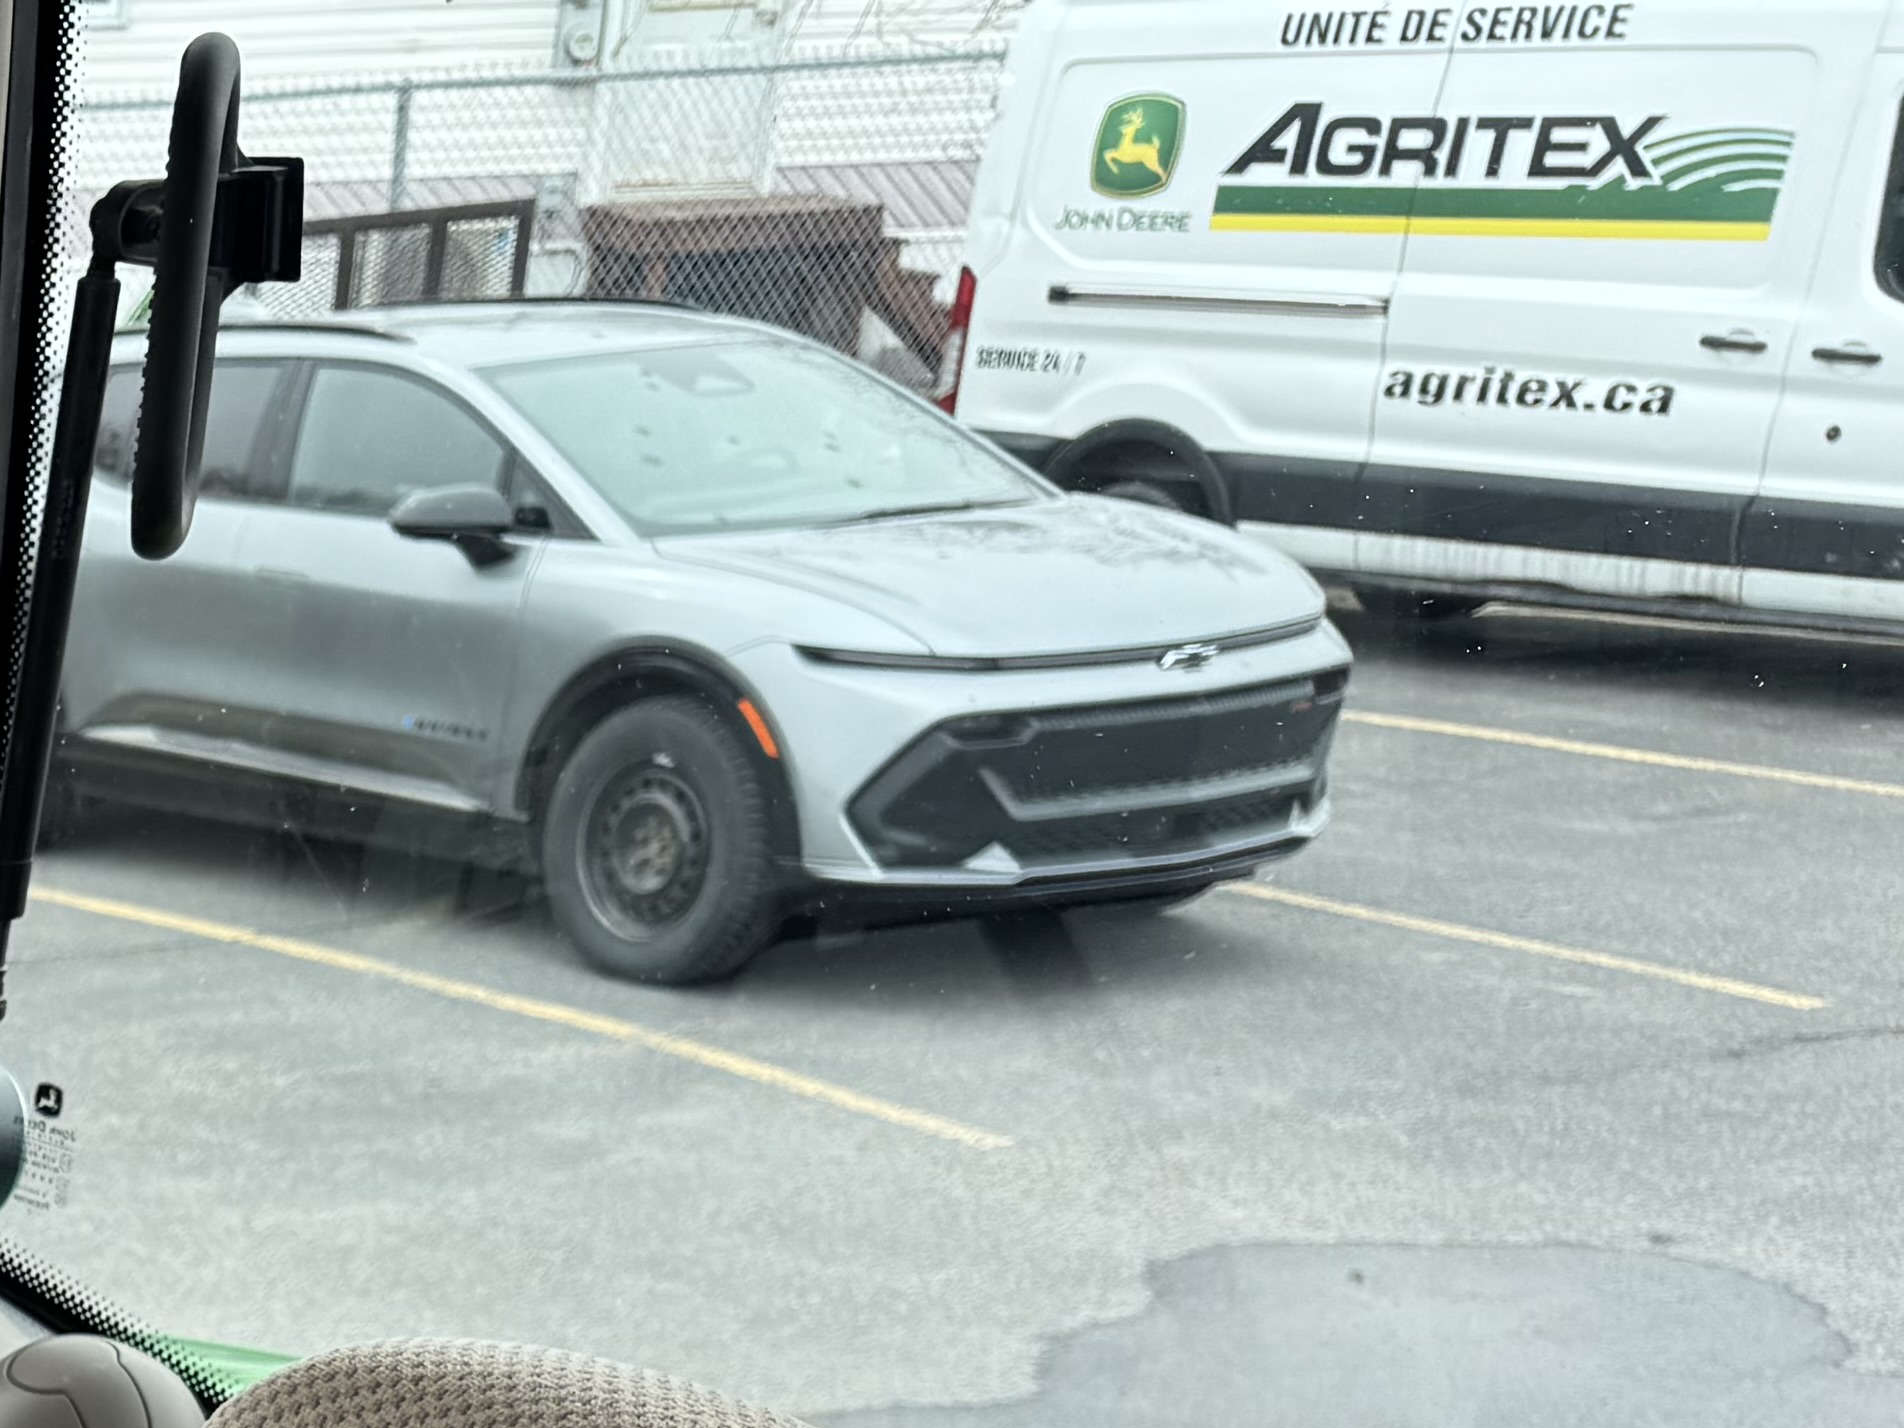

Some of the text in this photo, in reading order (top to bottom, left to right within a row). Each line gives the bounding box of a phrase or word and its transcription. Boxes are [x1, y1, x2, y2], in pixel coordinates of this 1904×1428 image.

[1399, 9, 1451, 43] DE
[1460, 3, 1635, 43] SERVICE
[1223, 101, 1666, 181] AGRITEX
[1383, 366, 1676, 417] agritex.ca
